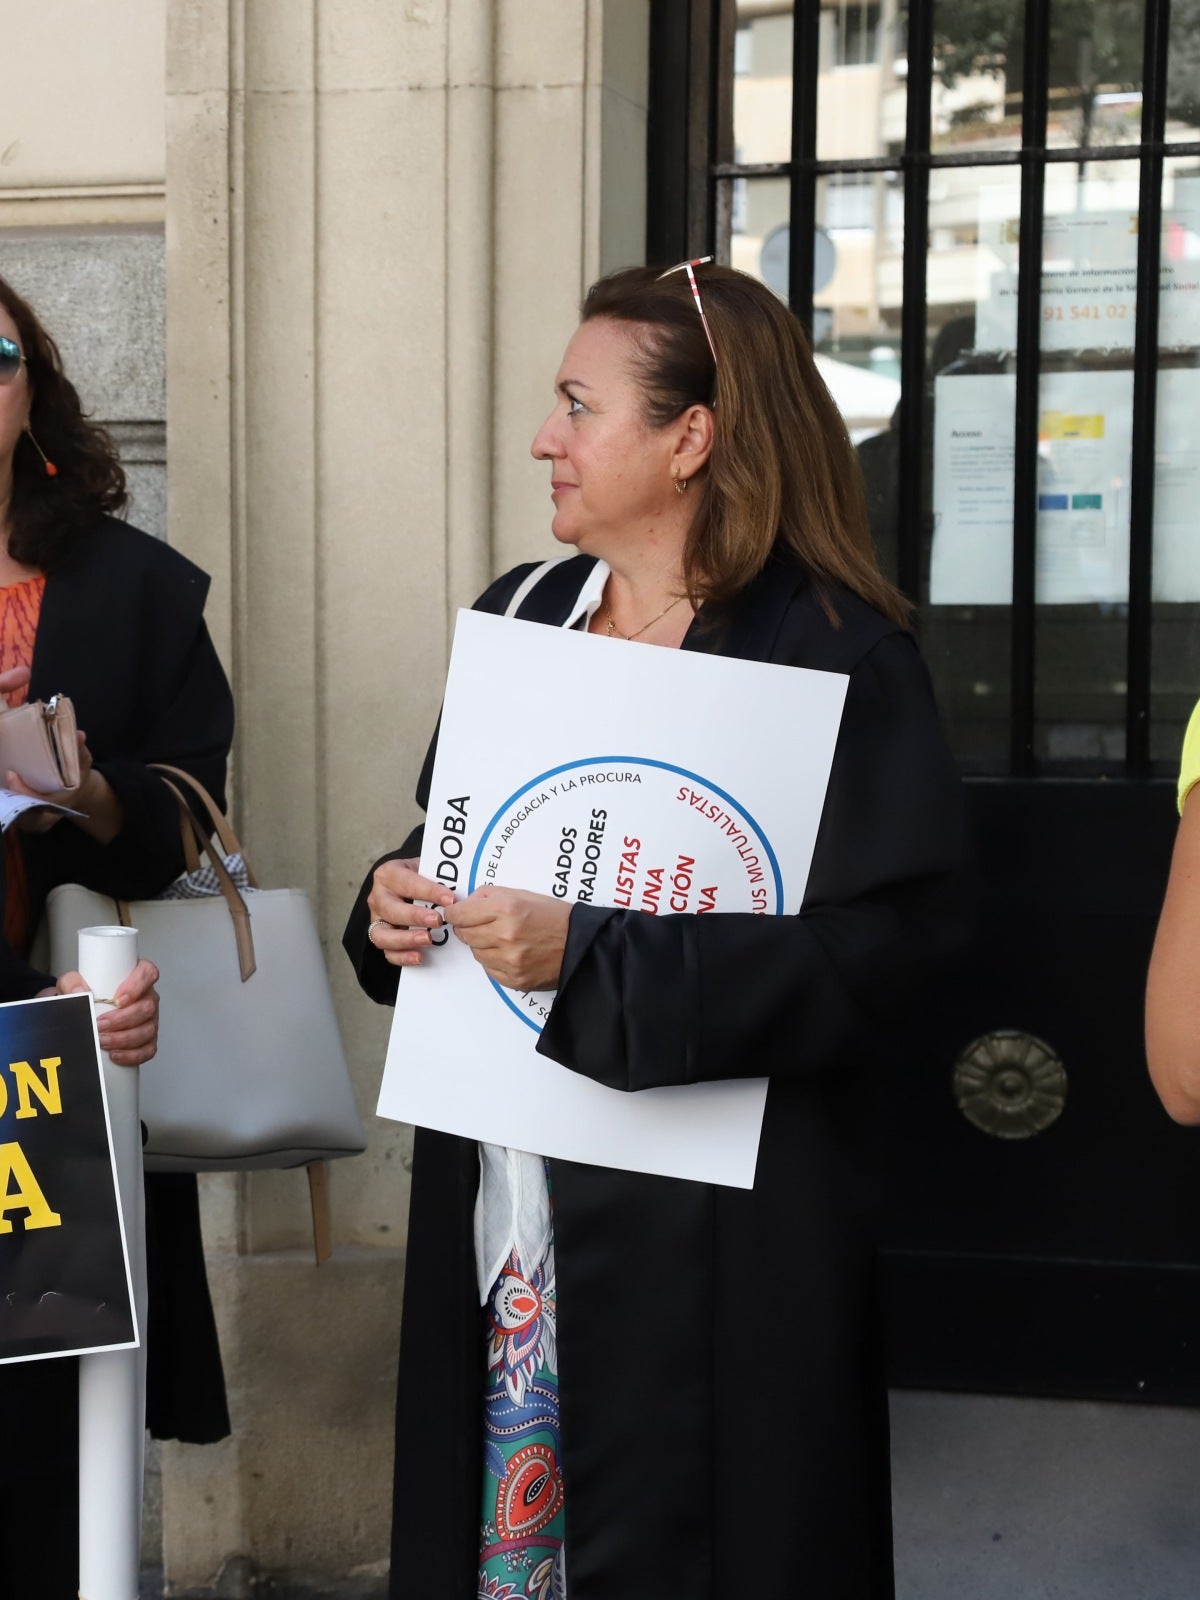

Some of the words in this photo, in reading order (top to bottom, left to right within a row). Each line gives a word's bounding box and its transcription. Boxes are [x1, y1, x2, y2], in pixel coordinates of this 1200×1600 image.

[1070, 305, 1100, 320] 541
[486, 860, 498, 878] DE
[492, 845, 505, 859] LA
[501, 793, 550, 843] ABOGACIA
[549, 786, 558, 796] Y
[561, 780, 577, 792] LA
[579, 772, 642, 786] PROCURA
[676, 786, 764, 884] MUTUALISTAS
